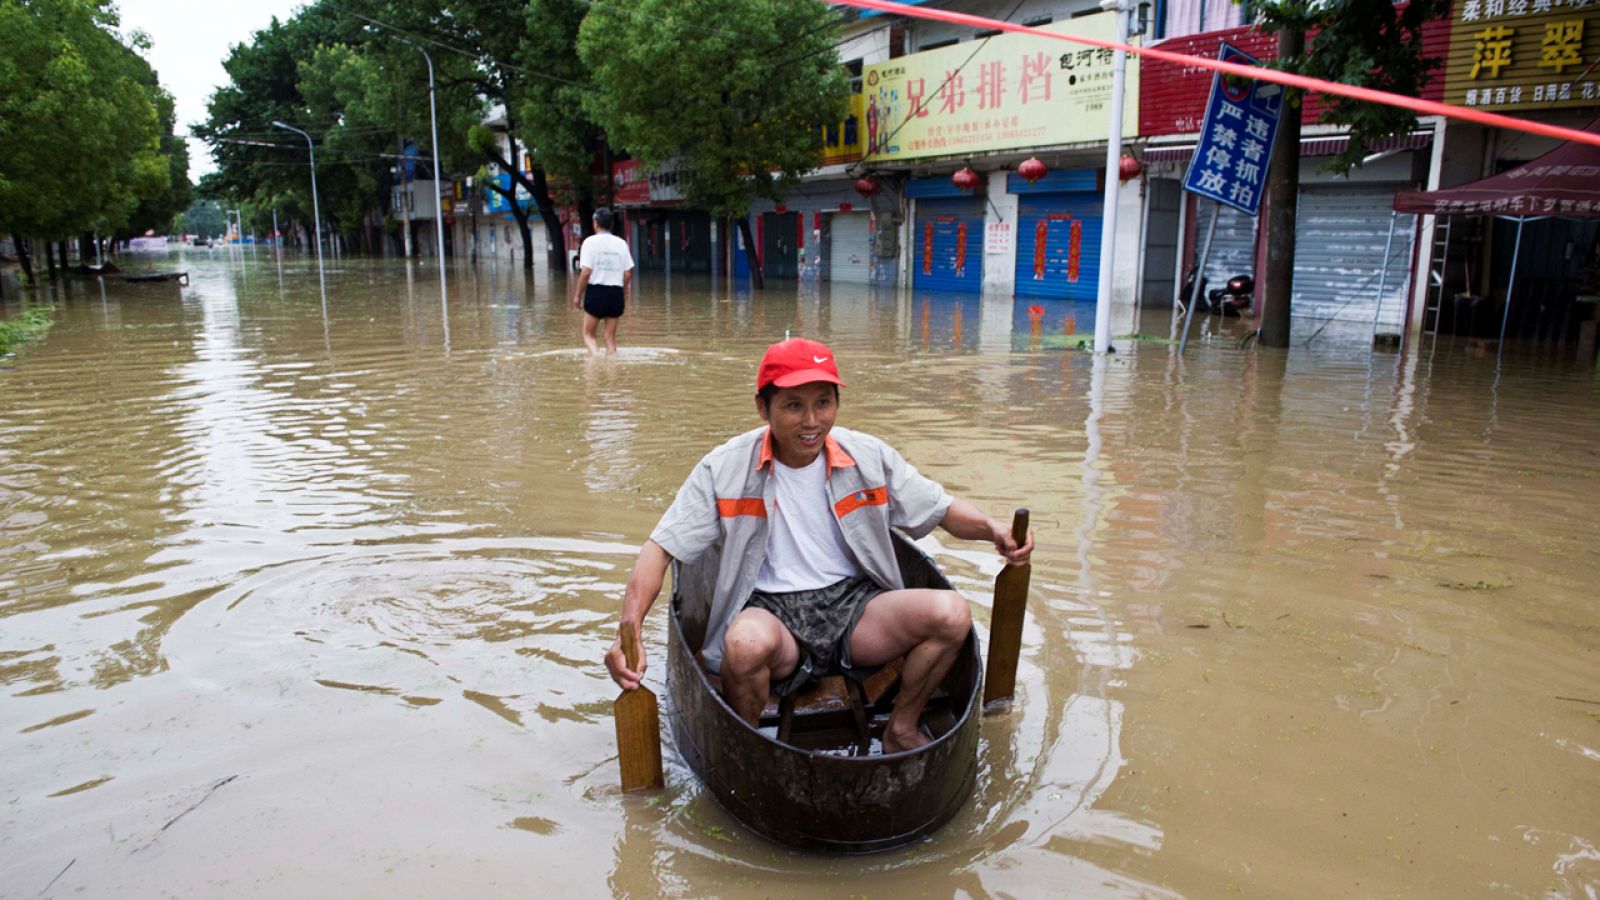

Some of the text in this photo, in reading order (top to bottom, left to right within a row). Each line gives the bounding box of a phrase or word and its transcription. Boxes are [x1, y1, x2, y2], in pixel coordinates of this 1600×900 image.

[904, 52, 1053, 119] 兄弟排档
[1060, 47, 1138, 70] 包河特
[1533, 83, 1572, 102] 日用品
[1196, 99, 1245, 196] 严禁停放
[1229, 114, 1271, 207] 违者抓拍
